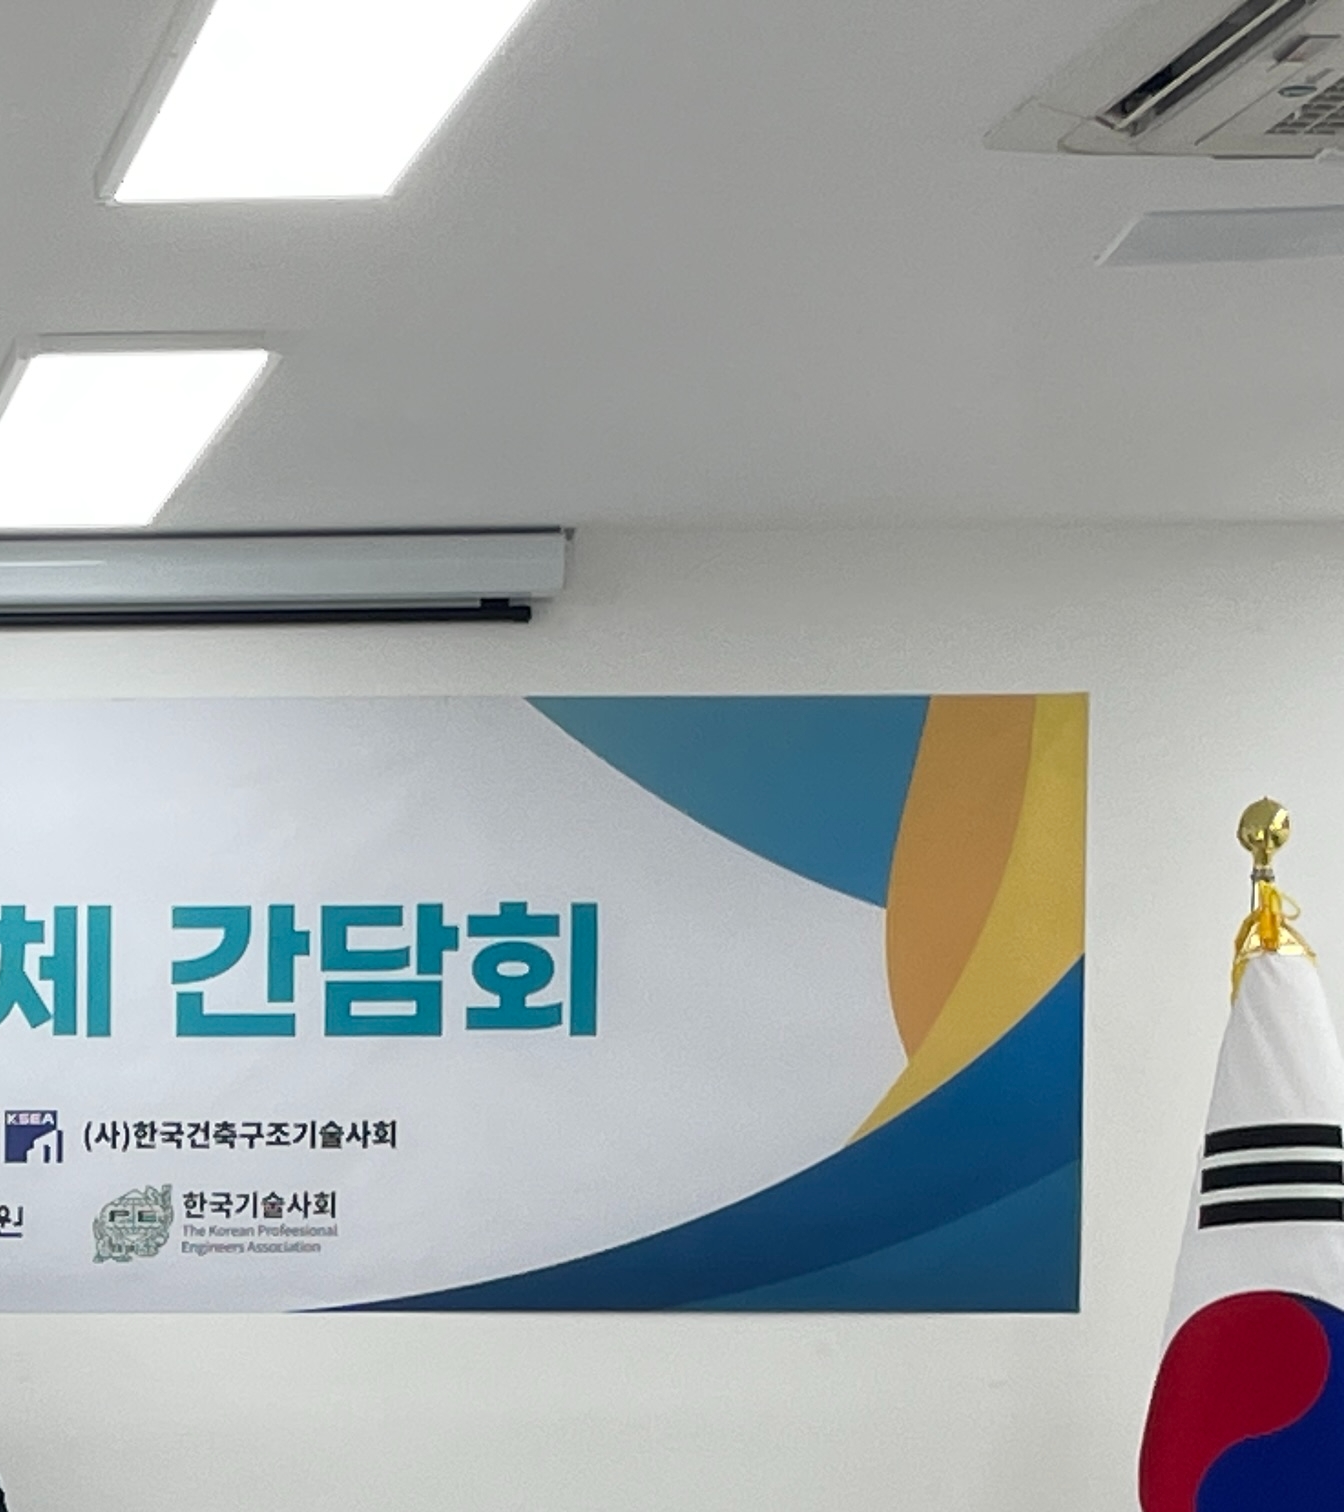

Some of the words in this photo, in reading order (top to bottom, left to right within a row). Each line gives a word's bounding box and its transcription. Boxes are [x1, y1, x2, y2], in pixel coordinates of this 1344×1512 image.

[171, 901, 599, 1038] 간담회
[7, 1113, 54, 1125] KSEA
[84, 1120, 397, 1152] (사)한국건축구조기술사회
[183, 1191, 336, 1219] 한국기술사회
[183, 1225, 205, 1237] The
[209, 1225, 254, 1237] Korean
[181, 1241, 244, 1256] Engineers
[247, 1241, 321, 1253] Association
